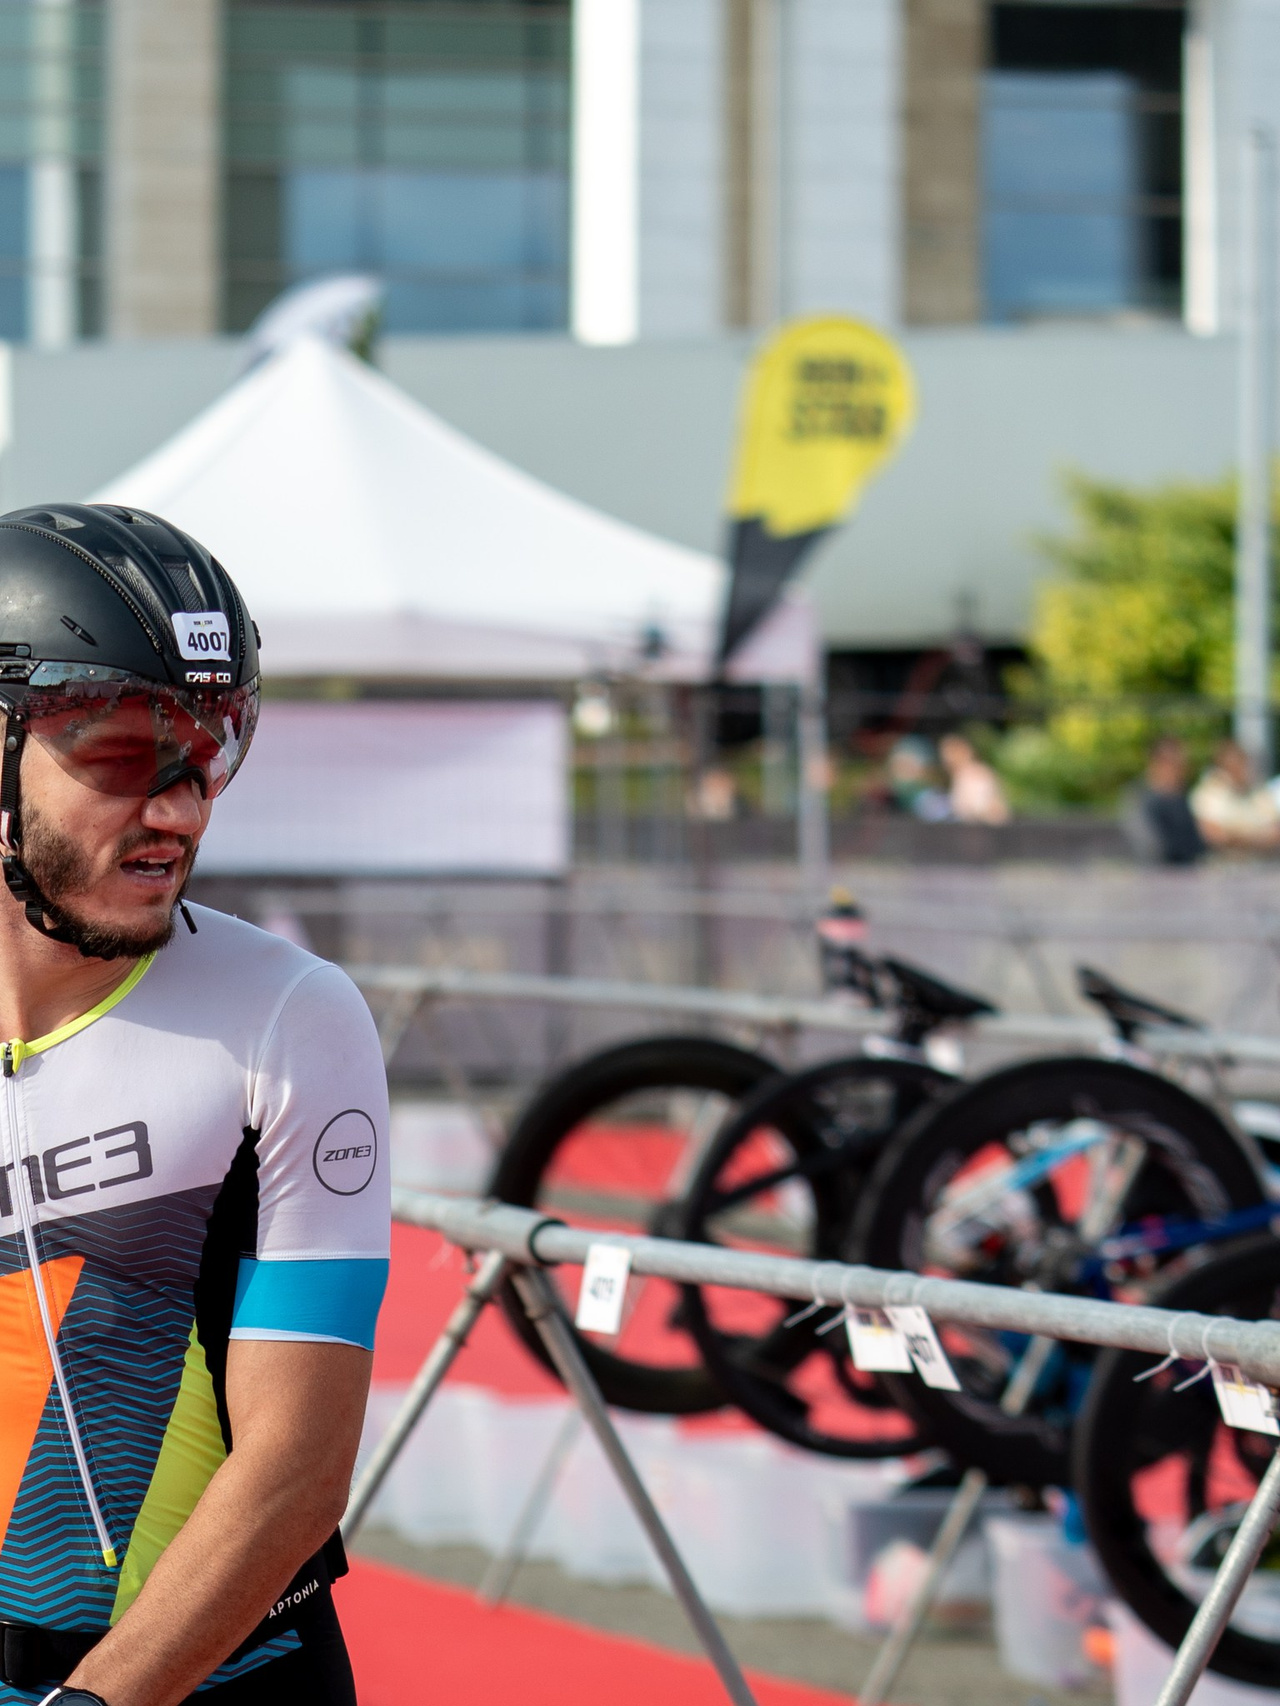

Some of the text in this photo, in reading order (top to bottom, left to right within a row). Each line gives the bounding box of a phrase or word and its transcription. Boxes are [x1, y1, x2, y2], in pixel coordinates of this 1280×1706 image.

[187, 631, 228, 653] 4007
[322, 1145, 372, 1163] ZONE3
[268, 1578, 320, 1620] APTONIA
